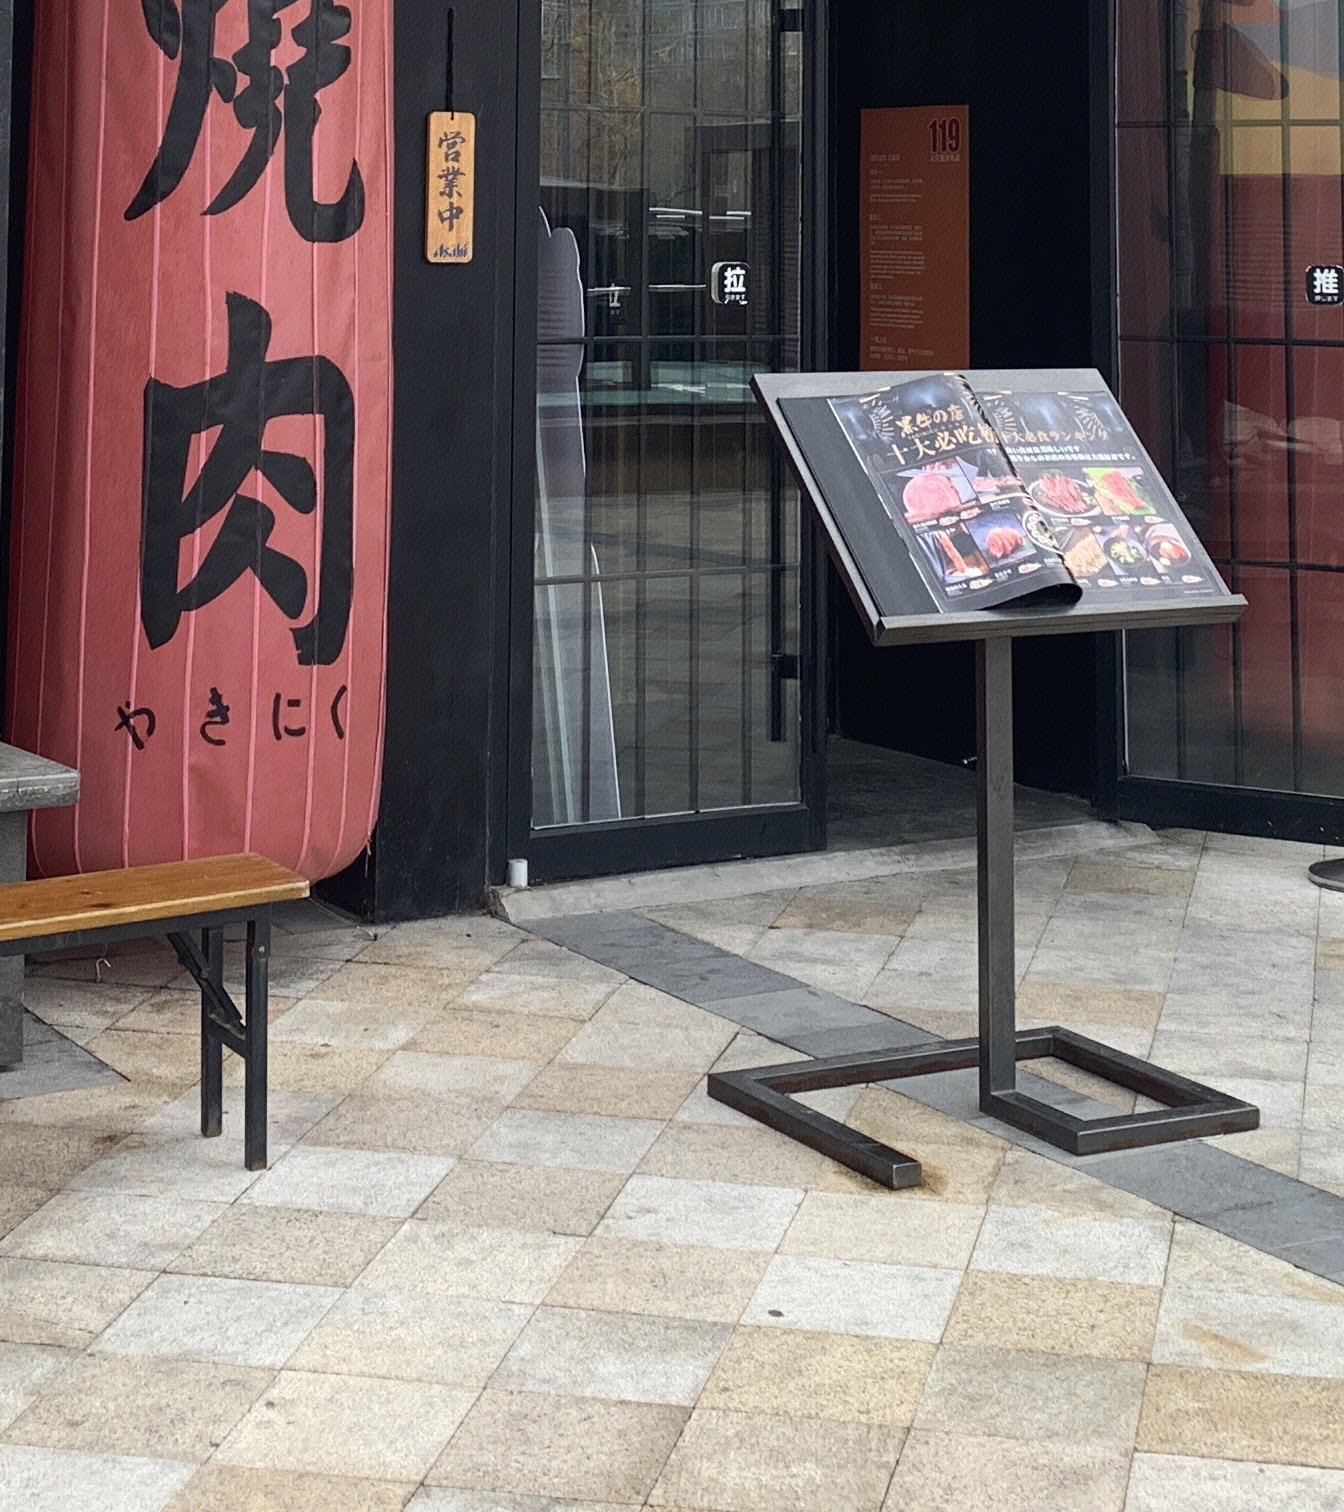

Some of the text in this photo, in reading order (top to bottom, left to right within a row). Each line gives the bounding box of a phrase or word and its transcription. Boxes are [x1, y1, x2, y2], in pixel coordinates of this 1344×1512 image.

[928, 117, 961, 154] 119
[724, 266, 746, 292] 拉
[1313, 268, 1339, 294] 推
[114, 685, 347, 750] やきにく
